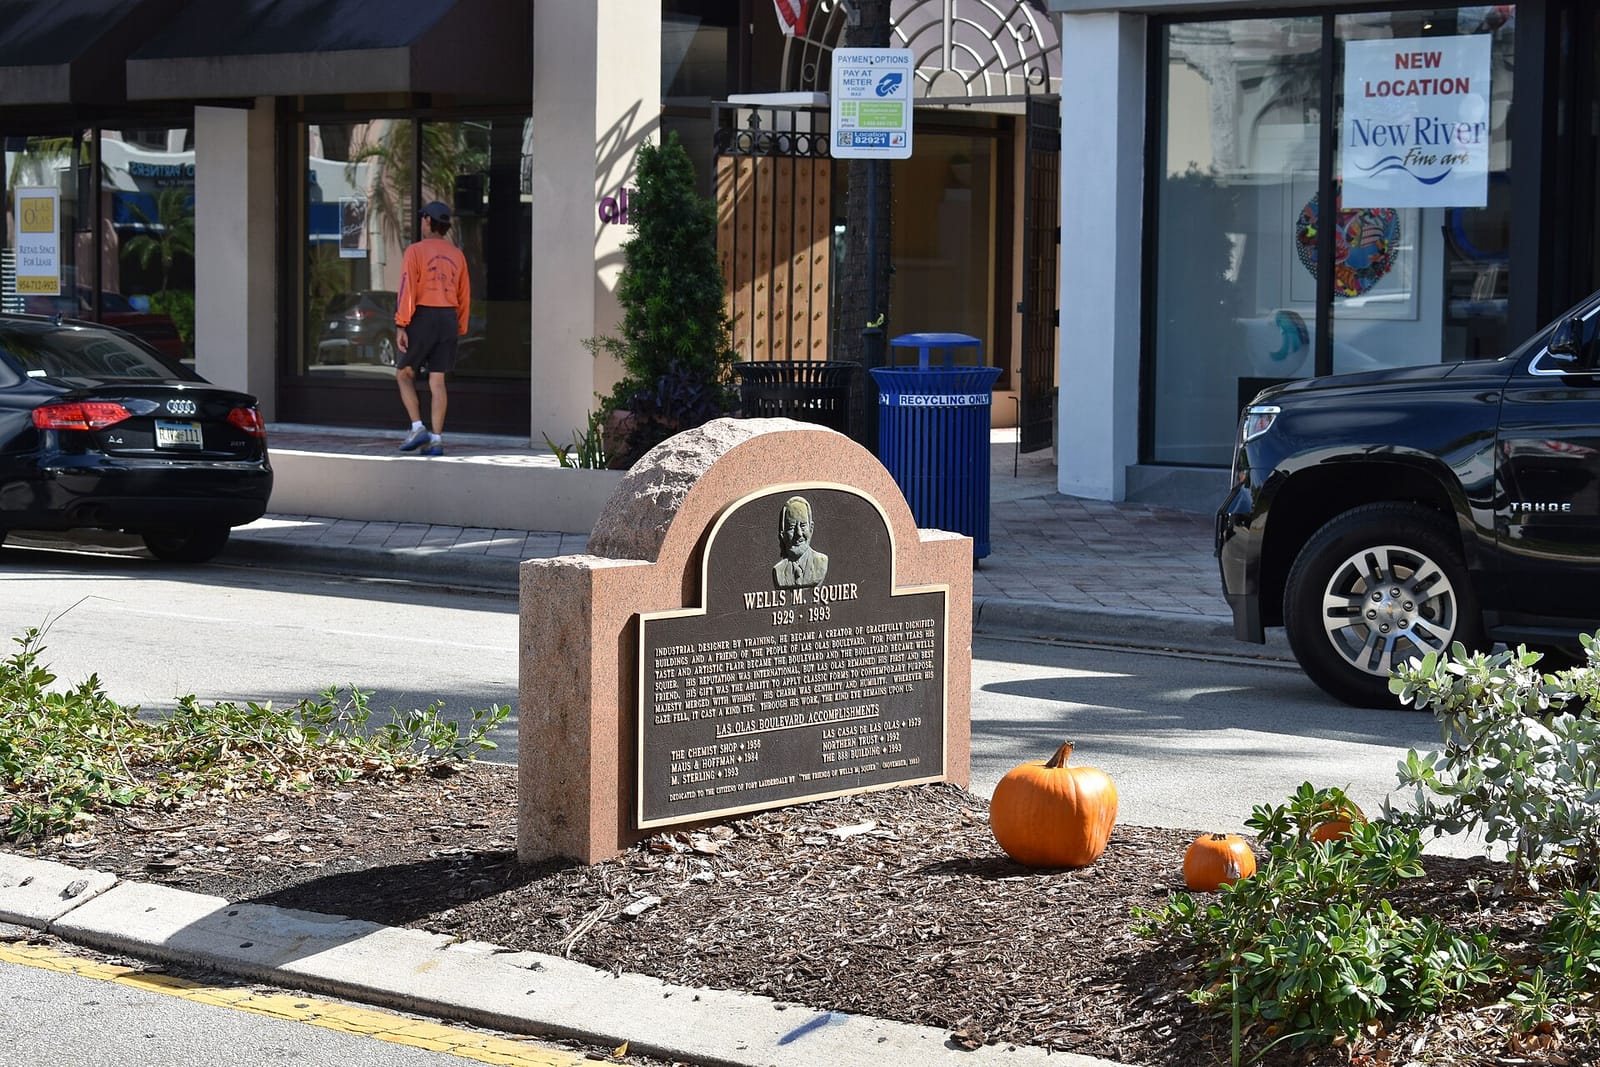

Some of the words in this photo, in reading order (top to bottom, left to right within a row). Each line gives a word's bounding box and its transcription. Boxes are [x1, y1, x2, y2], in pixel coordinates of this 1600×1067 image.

[838, 55, 873, 64] PAYMENT
[875, 55, 909, 64] OPTIONS
[1395, 51, 1442, 70] NEW
[1364, 77, 1470, 98] LOCATION
[1403, 147, 1438, 166] Fine
[900, 395, 965, 405] RECYCLING
[968, 394, 989, 404] ONLY
[108, 435, 123, 444] A4
[1510, 502, 1571, 512] TAHOE
[744, 589, 786, 610] WELLS
[793, 588, 807, 605] M.
[813, 583, 858, 604] SQUIER
[773, 609, 794, 625] 1929
[808, 605, 830, 621] 1993
[655, 643, 694, 657] INDUSTRIAL
[698, 640, 729, 653] DESIGNER
[732, 638, 740, 649] BY
[744, 634, 776, 647] TRAINING,
[779, 633, 787, 644] HE
[790, 630, 814, 642] BECAME
[818, 629, 822, 639] A
[826, 626, 852, 638] CREATOR
[855, 625, 862, 635] OF
[866, 621, 902, 634] GRACEFULLY
[905, 617, 934, 629] DIGNIFIED
[655, 655, 688, 668] BUILDINGS
[692, 653, 704, 664] AND
[708, 652, 712, 662] A
[716, 650, 737, 661] FRIEND
[740, 648, 748, 658] OF
[751, 647, 762, 657] THE
[766, 644, 786, 656] PEOPLE
[790, 643, 797, 653] OF
[801, 641, 811, 652] LAS
[815, 639, 829, 650] OLAS
[872, 633, 883, 643] FOR
[886, 631, 902, 642] FORTY
[905, 629, 922, 640] YEARS
[925, 628, 934, 637] HIS
[655, 668, 674, 679] TASTE
[678, 666, 691, 676] AND
[694, 662, 722, 675] ARTISTIC
[726, 660, 744, 671] FLAIR
[747, 657, 771, 668] BECAME
[774, 655, 785, 665] THE
[788, 651, 823, 664] BOULEVARD
[826, 649, 838, 659] AND
[841, 648, 851, 658] THE
[854, 643, 888, 656] BOULEVARD
[891, 640, 912, 652] BECAME
[916, 638, 934, 649] WELLS
[686, 676, 696, 687] HIS
[699, 672, 735, 685] REPUTATION
[738, 670, 750, 680] WAS
[754, 664, 800, 679] INTERNATIONAL,
[803, 663, 814, 673] BUT
[817, 661, 827, 671] LAS
[830, 659, 844, 669] OLAS
[847, 655, 875, 667] REMAINED
[878, 654, 887, 664] HIS
[890, 652, 904, 662] FIRST
[908, 650, 918, 660] AND
[921, 649, 933, 659] BEST
[655, 690, 680, 702] FRIEND.
[686, 688, 696, 698] HIS
[699, 686, 712, 696] GIFT
[715, 684, 728, 694] WAS
[731, 682, 742, 692] THE
[746, 679, 769, 691] ABILITY
[771, 678, 780, 688] TO
[782, 675, 800, 686] APPLY
[803, 672, 827, 684] CLASSIC
[829, 669, 848, 680] FORMS
[850, 668, 858, 678] TO
[860, 663, 905, 677] CONTEMPORARY
[655, 701, 681, 713] MAJESTY
[685, 697, 709, 709] MERGED
[713, 695, 728, 706] WITH
[732, 692, 756, 704] WHIMSY.
[763, 690, 773, 700] HIS
[776, 687, 796, 698] CHARM
[799, 685, 811, 695] WAS
[814, 681, 842, 693] GENTILITY
[846, 679, 857, 689] AND
[893, 671, 921, 683] WHEREVER
[924, 670, 933, 679] HIS
[655, 713, 670, 724] GAZE
[673, 711, 689, 722] FELL,
[692, 710, 698, 720] IT
[701, 708, 715, 719] CAST
[718, 707, 722, 716] A
[725, 704, 740, 716] KIND
[742, 703, 755, 713] EYE.
[760, 699, 787, 711] THROUGH
[789, 697, 798, 707] HIS
[800, 694, 819, 706] WORK,
[821, 693, 832, 703] THE
[834, 691, 848, 702] KIND
[850, 689, 861, 700] EYE
[863, 686, 886, 698] REMAINS
[888, 684, 903, 695] UPON
[716, 722, 731, 735] LAS
[735, 719, 755, 732] OLAS
[759, 712, 804, 729] BOULEVARD
[808, 703, 879, 723] ACCOMPLISHMENTS
[822, 728, 835, 739] LAS
[837, 725, 857, 737] CASAS
[859, 723, 867, 734] DE
[869, 722, 881, 733] LAS
[884, 719, 899, 731] OLAS
[671, 748, 684, 760] THE
[688, 744, 716, 758] CHEMIST
[720, 741, 737, 753] SHOP
[822, 752, 834, 763] THE
[851, 746, 879, 759] BUILDING
[888, 742, 901, 754] 1993
[823, 737, 855, 751] NORTHERN
[858, 734, 877, 746] TRUST
[671, 760, 690, 773] MAUS
[694, 759, 698, 770] &
[702, 754, 734, 769] HOFFMAN
[671, 774, 679, 786] M.
[683, 770, 714, 784] STERLING
[724, 766, 738, 778] 1993
